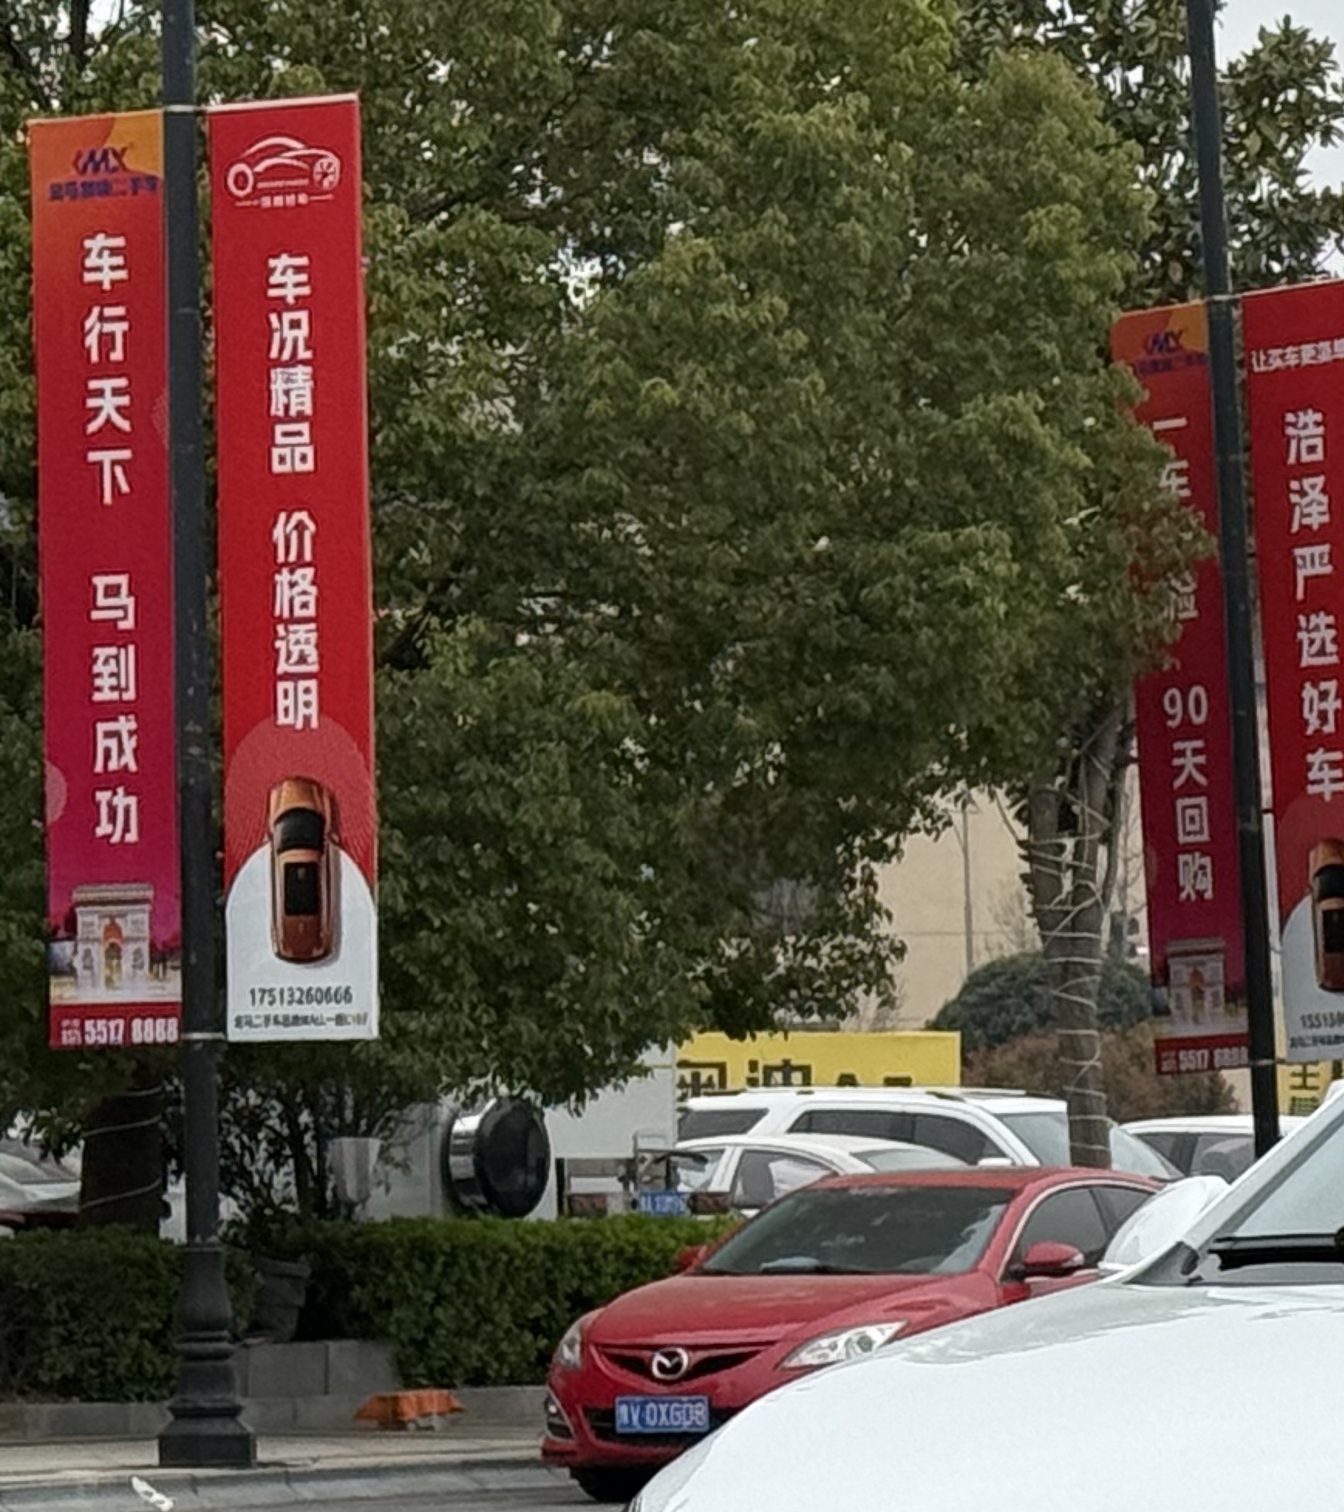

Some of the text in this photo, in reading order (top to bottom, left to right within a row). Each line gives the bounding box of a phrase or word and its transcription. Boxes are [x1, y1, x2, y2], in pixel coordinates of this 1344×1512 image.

[267, 253, 315, 474] 车况精品
[82, 233, 139, 844] 车行天下 马到成功
[272, 510, 320, 729] 价格透明
[1163, 684, 1213, 901] 90天回购
